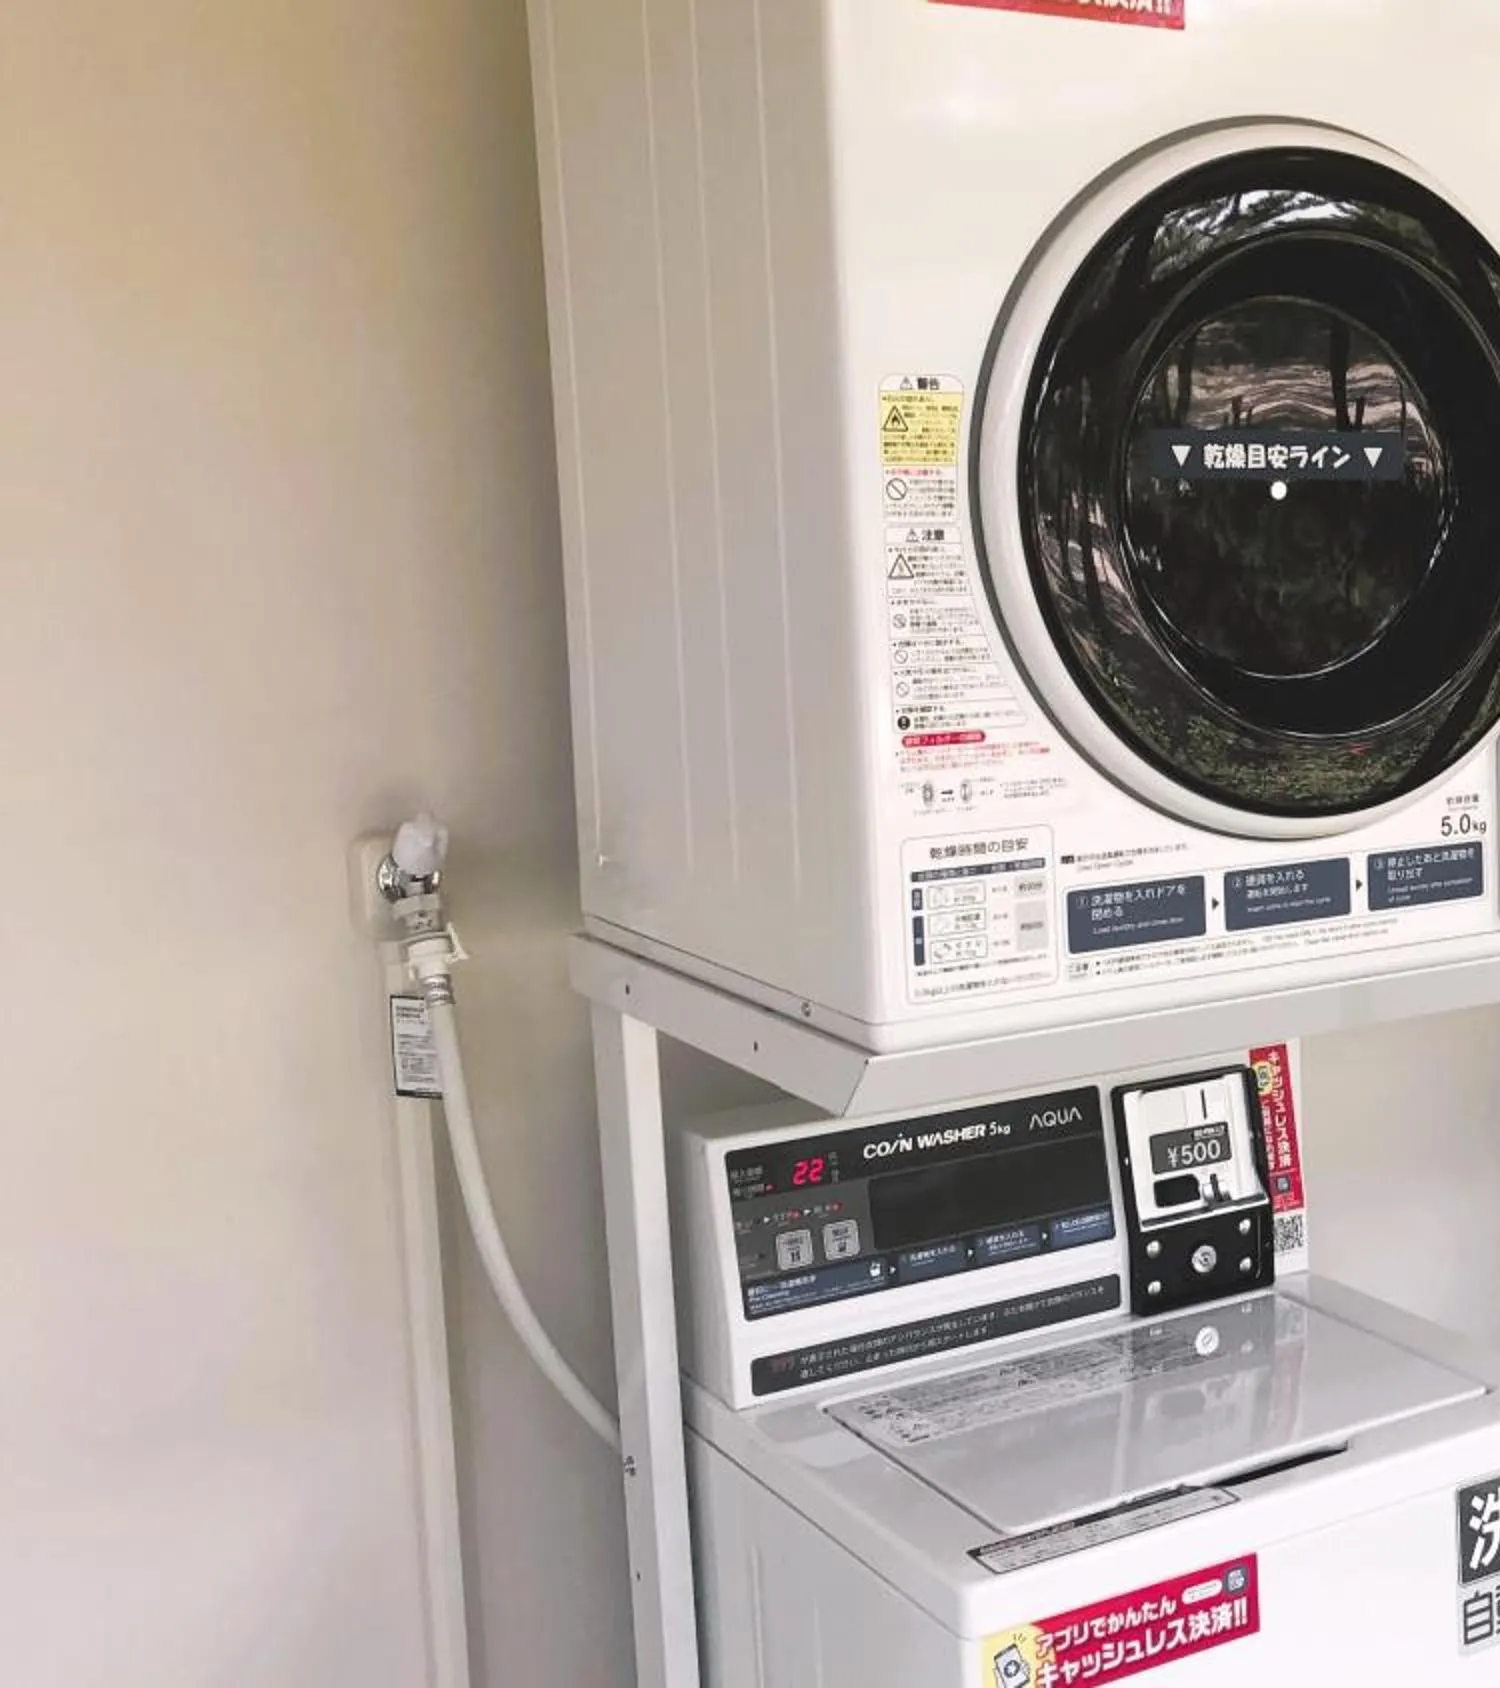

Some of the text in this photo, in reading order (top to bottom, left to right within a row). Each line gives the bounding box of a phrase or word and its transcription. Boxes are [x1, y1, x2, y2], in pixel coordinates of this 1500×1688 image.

[1203, 443, 1350, 469] 乾燥目安ライン
[1029, 1106, 1082, 1131] AQUA
[917, 1123, 986, 1149] WASHER
[1167, 1139, 1221, 1168] ¥500
[793, 1158, 824, 1185] 22
[1036, 1595, 1177, 1658] アプリでかんたん
[1037, 1597, 1248, 1688] キャッシュレス決済!!
